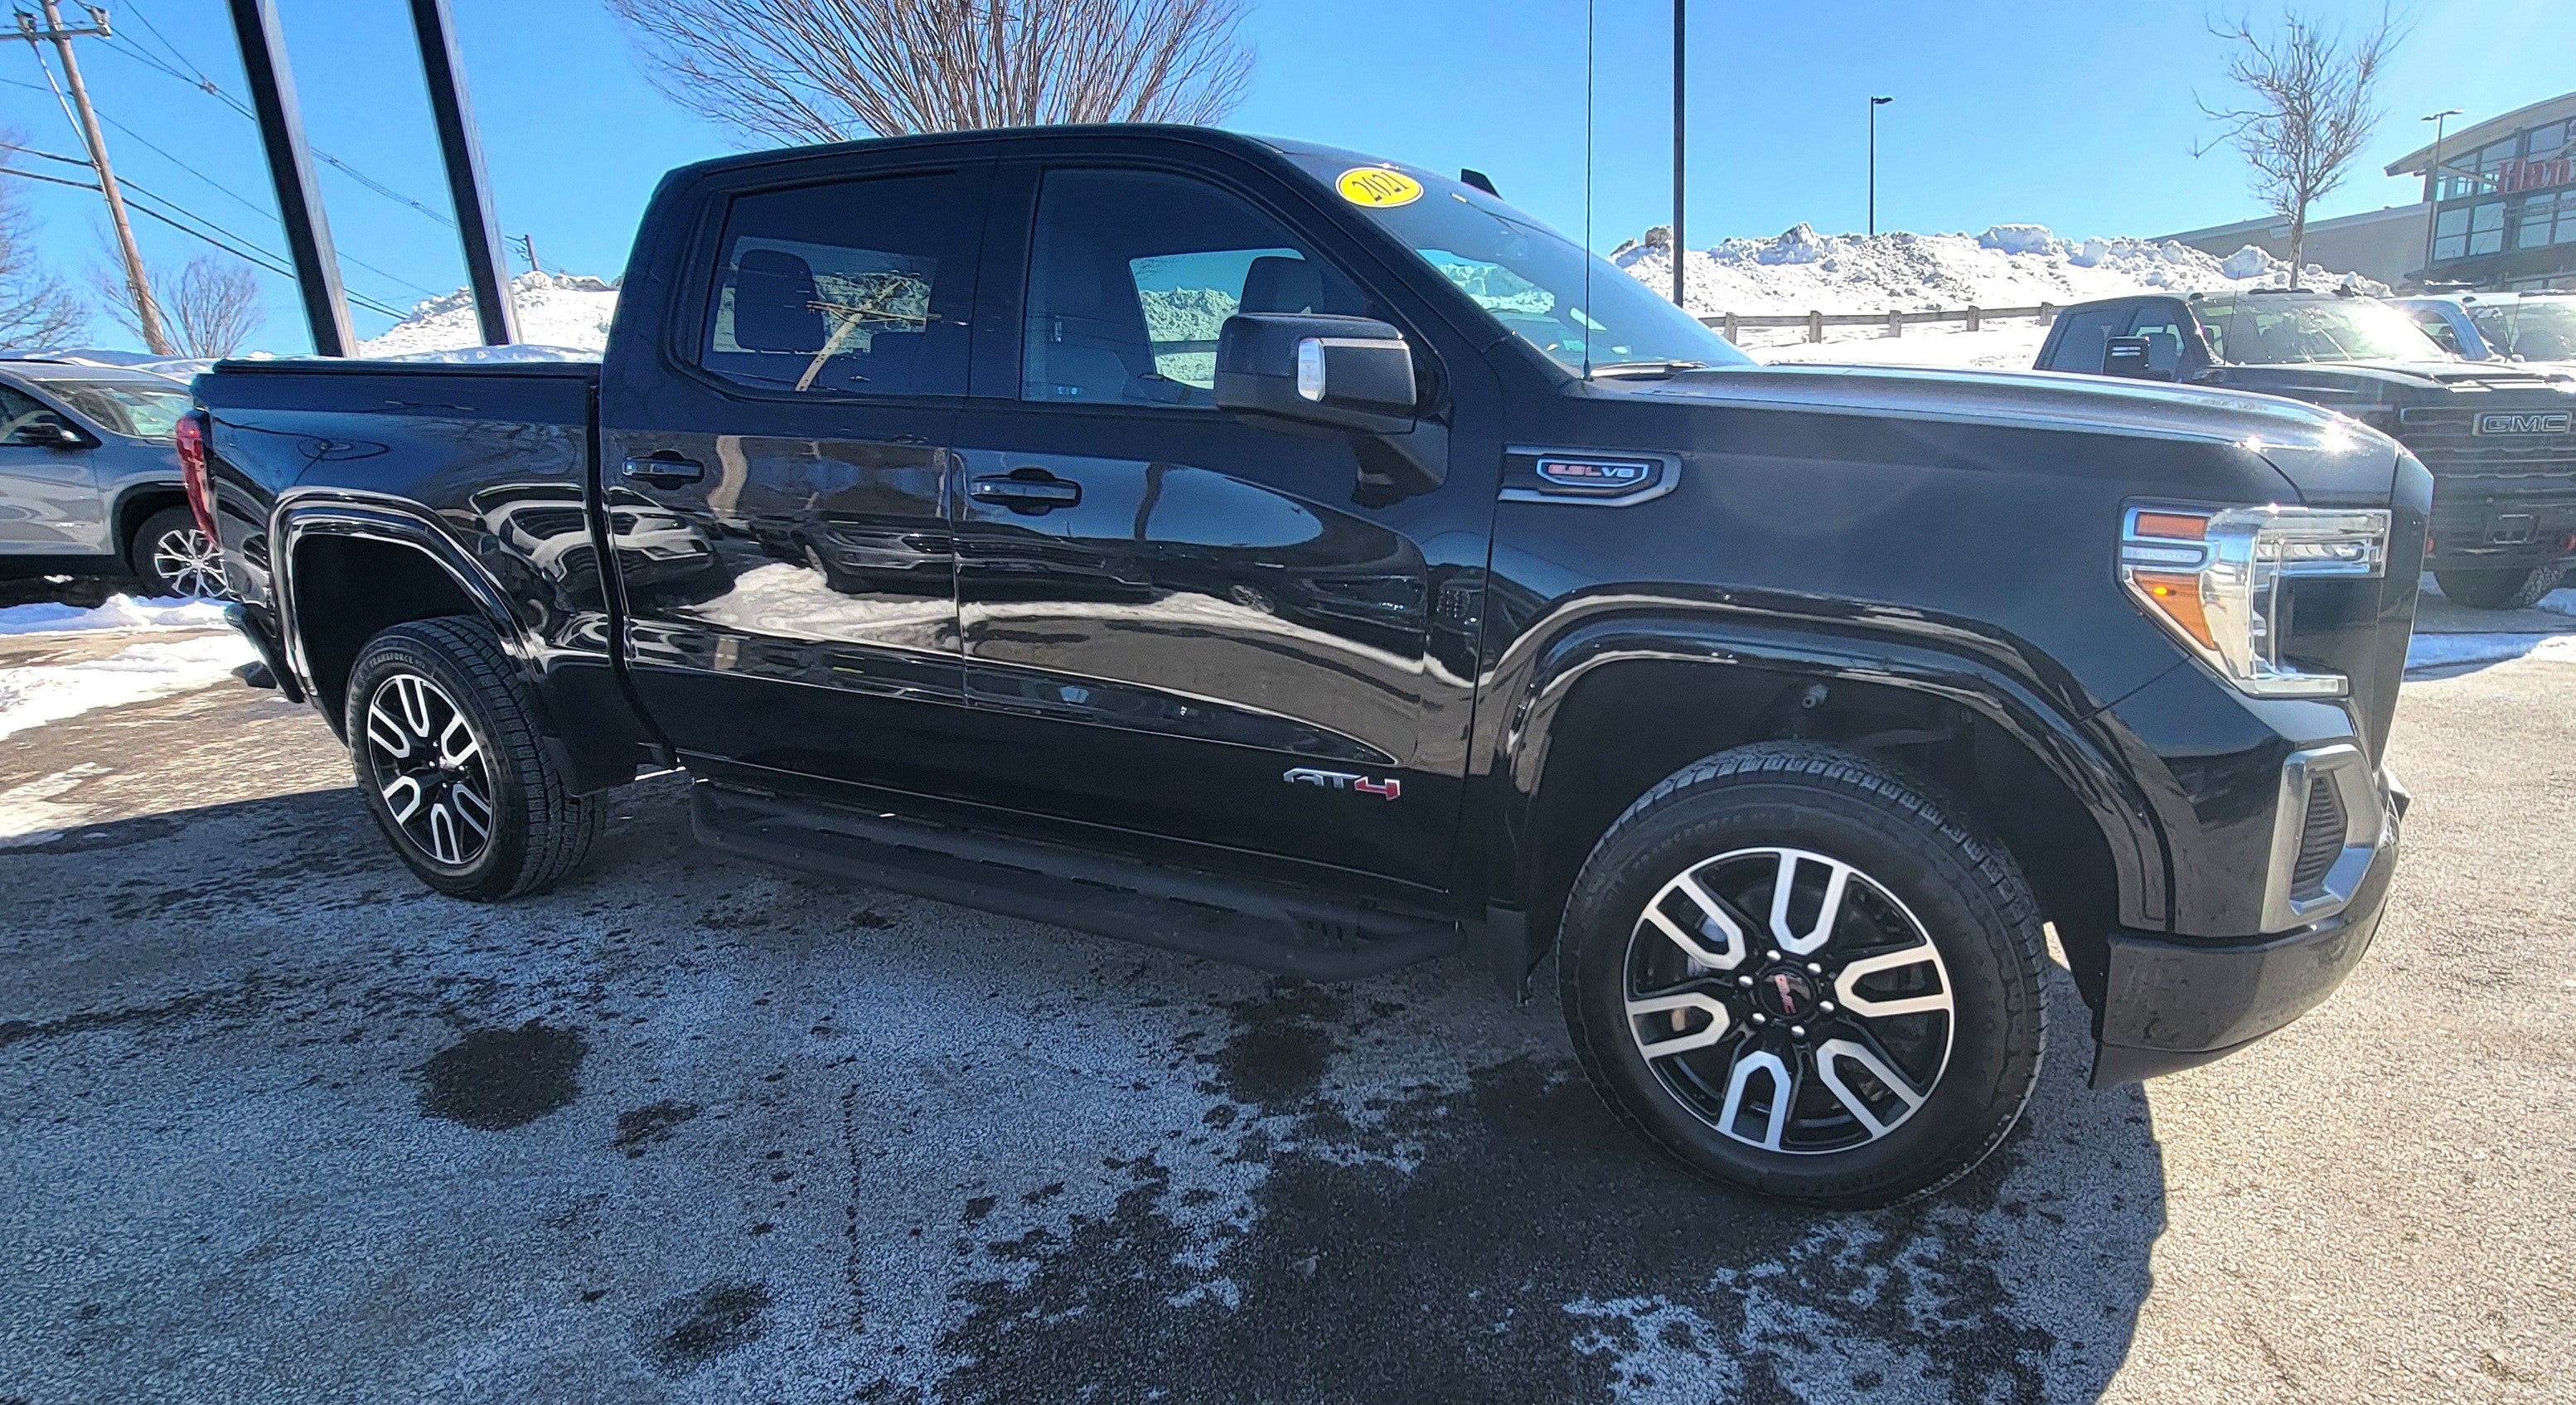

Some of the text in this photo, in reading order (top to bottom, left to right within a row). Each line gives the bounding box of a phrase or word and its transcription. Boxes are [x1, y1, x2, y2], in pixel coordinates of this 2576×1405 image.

[1352, 172, 1408, 201] 2021
[2482, 414, 2568, 434] GMC
[1284, 767, 1401, 802] AT4
